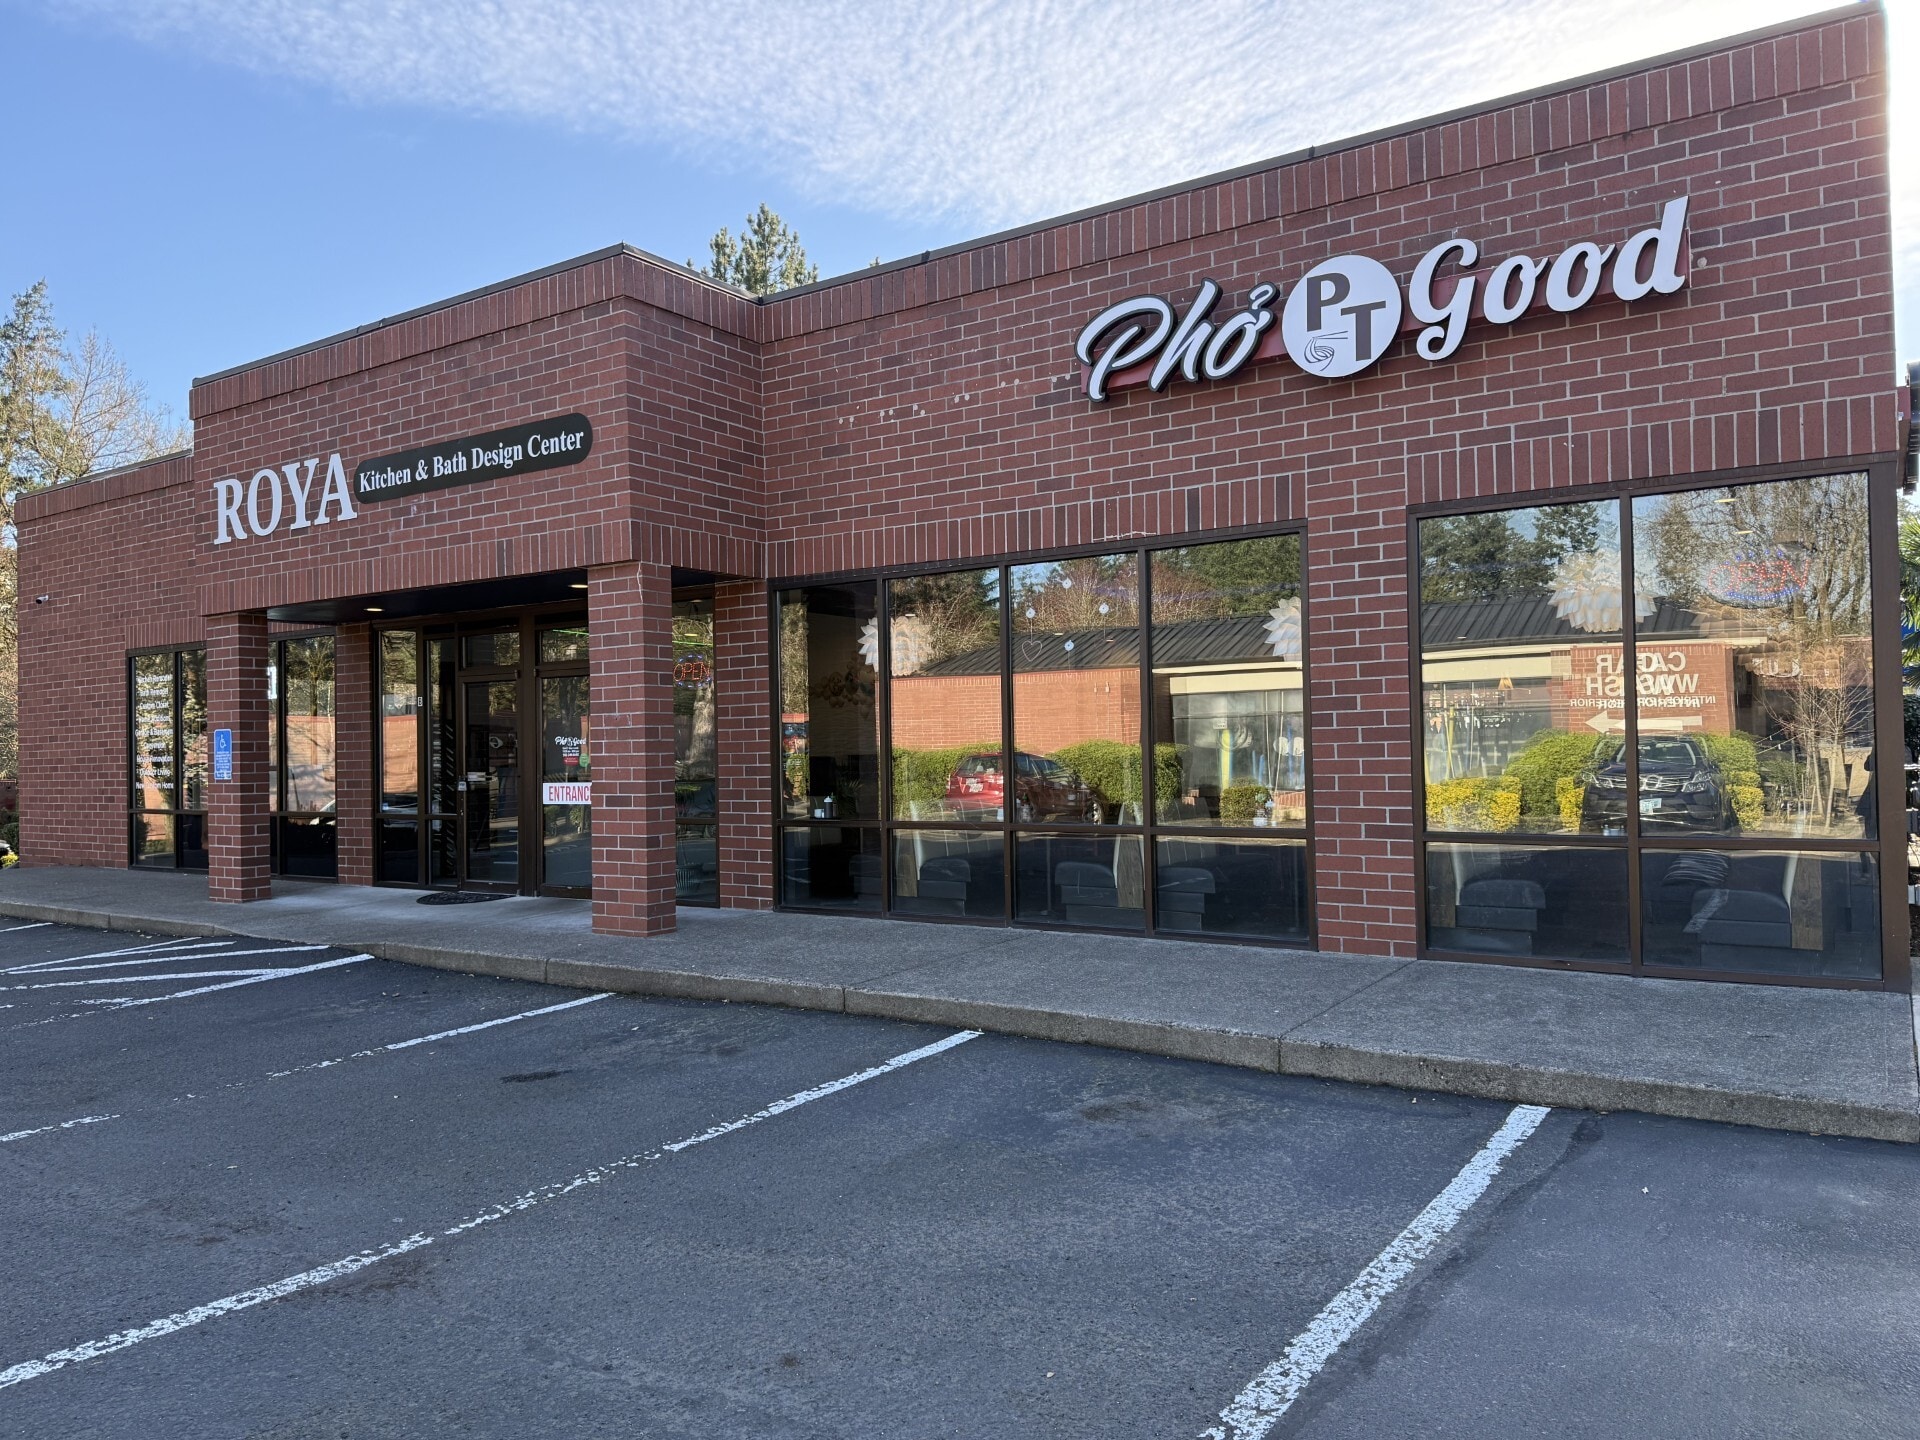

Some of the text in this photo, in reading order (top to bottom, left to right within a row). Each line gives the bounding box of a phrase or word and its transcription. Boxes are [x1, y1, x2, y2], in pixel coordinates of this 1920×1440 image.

[1409, 195, 1690, 361] Good
[359, 430, 584, 493] Kitchen & Bath Design Center
[213, 452, 357, 545] ROYA
[1708, 559, 1809, 593] OPEN
[673, 661, 711, 682] OPEN
[549, 786, 591, 801] ENTRANC
